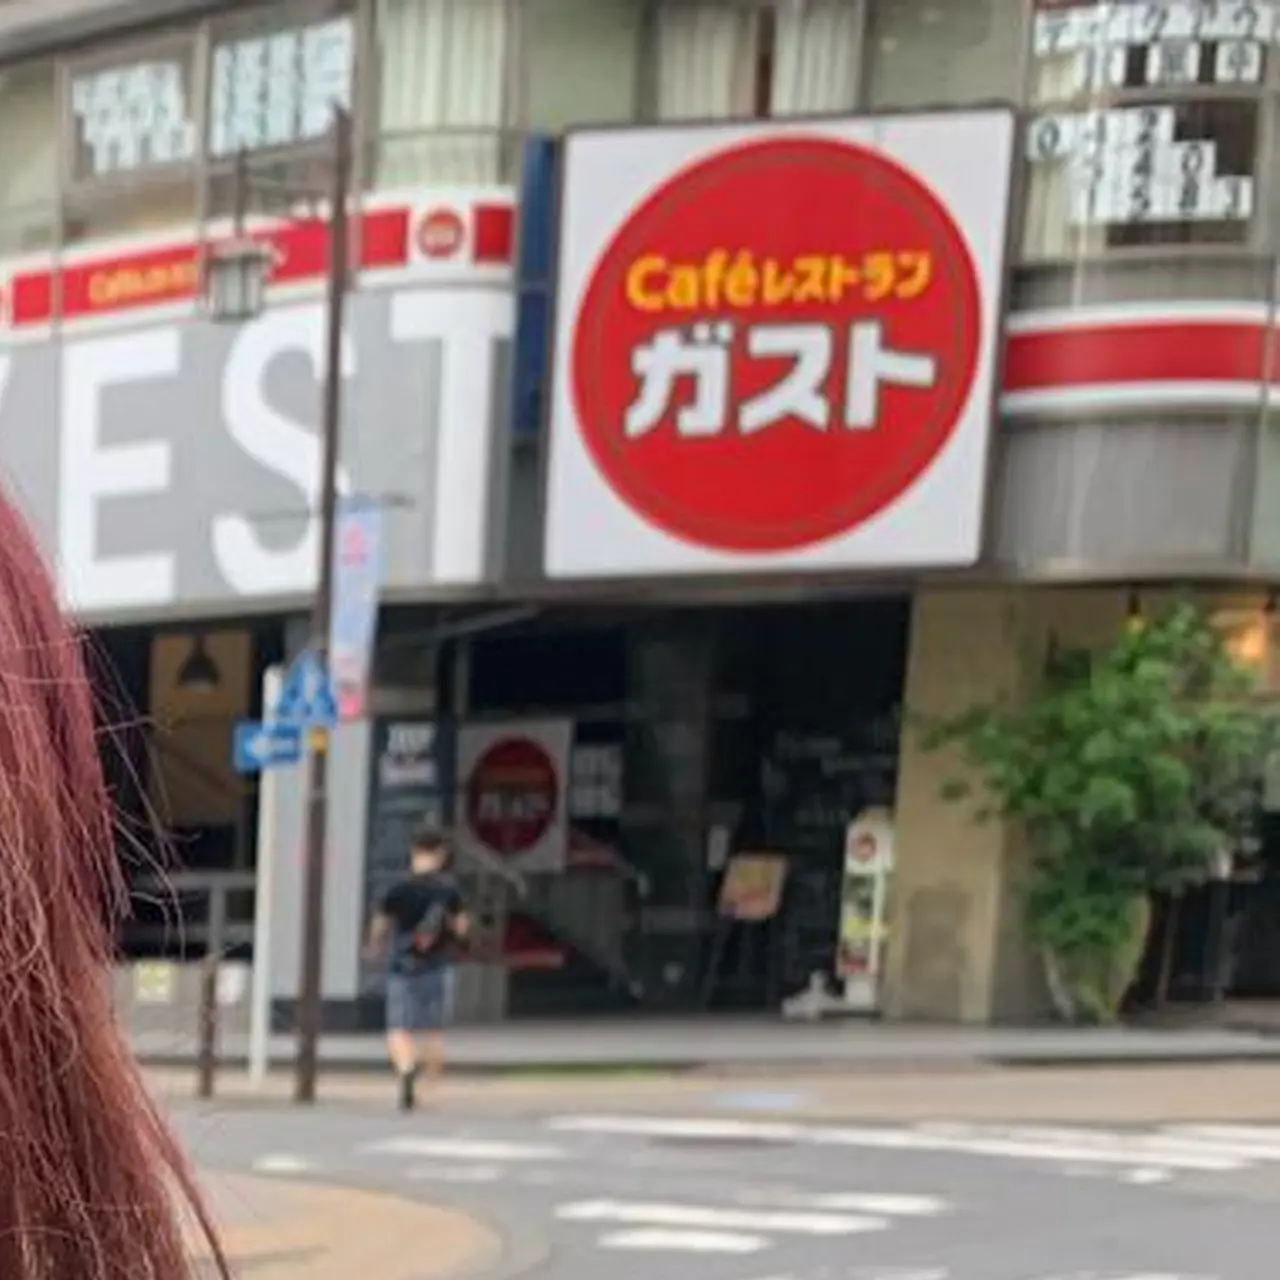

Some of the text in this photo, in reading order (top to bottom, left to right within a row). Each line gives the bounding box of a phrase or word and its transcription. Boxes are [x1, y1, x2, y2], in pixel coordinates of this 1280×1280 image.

[626, 248, 932, 314] Caféレストラン
[624, 317, 936, 439] ガスト
